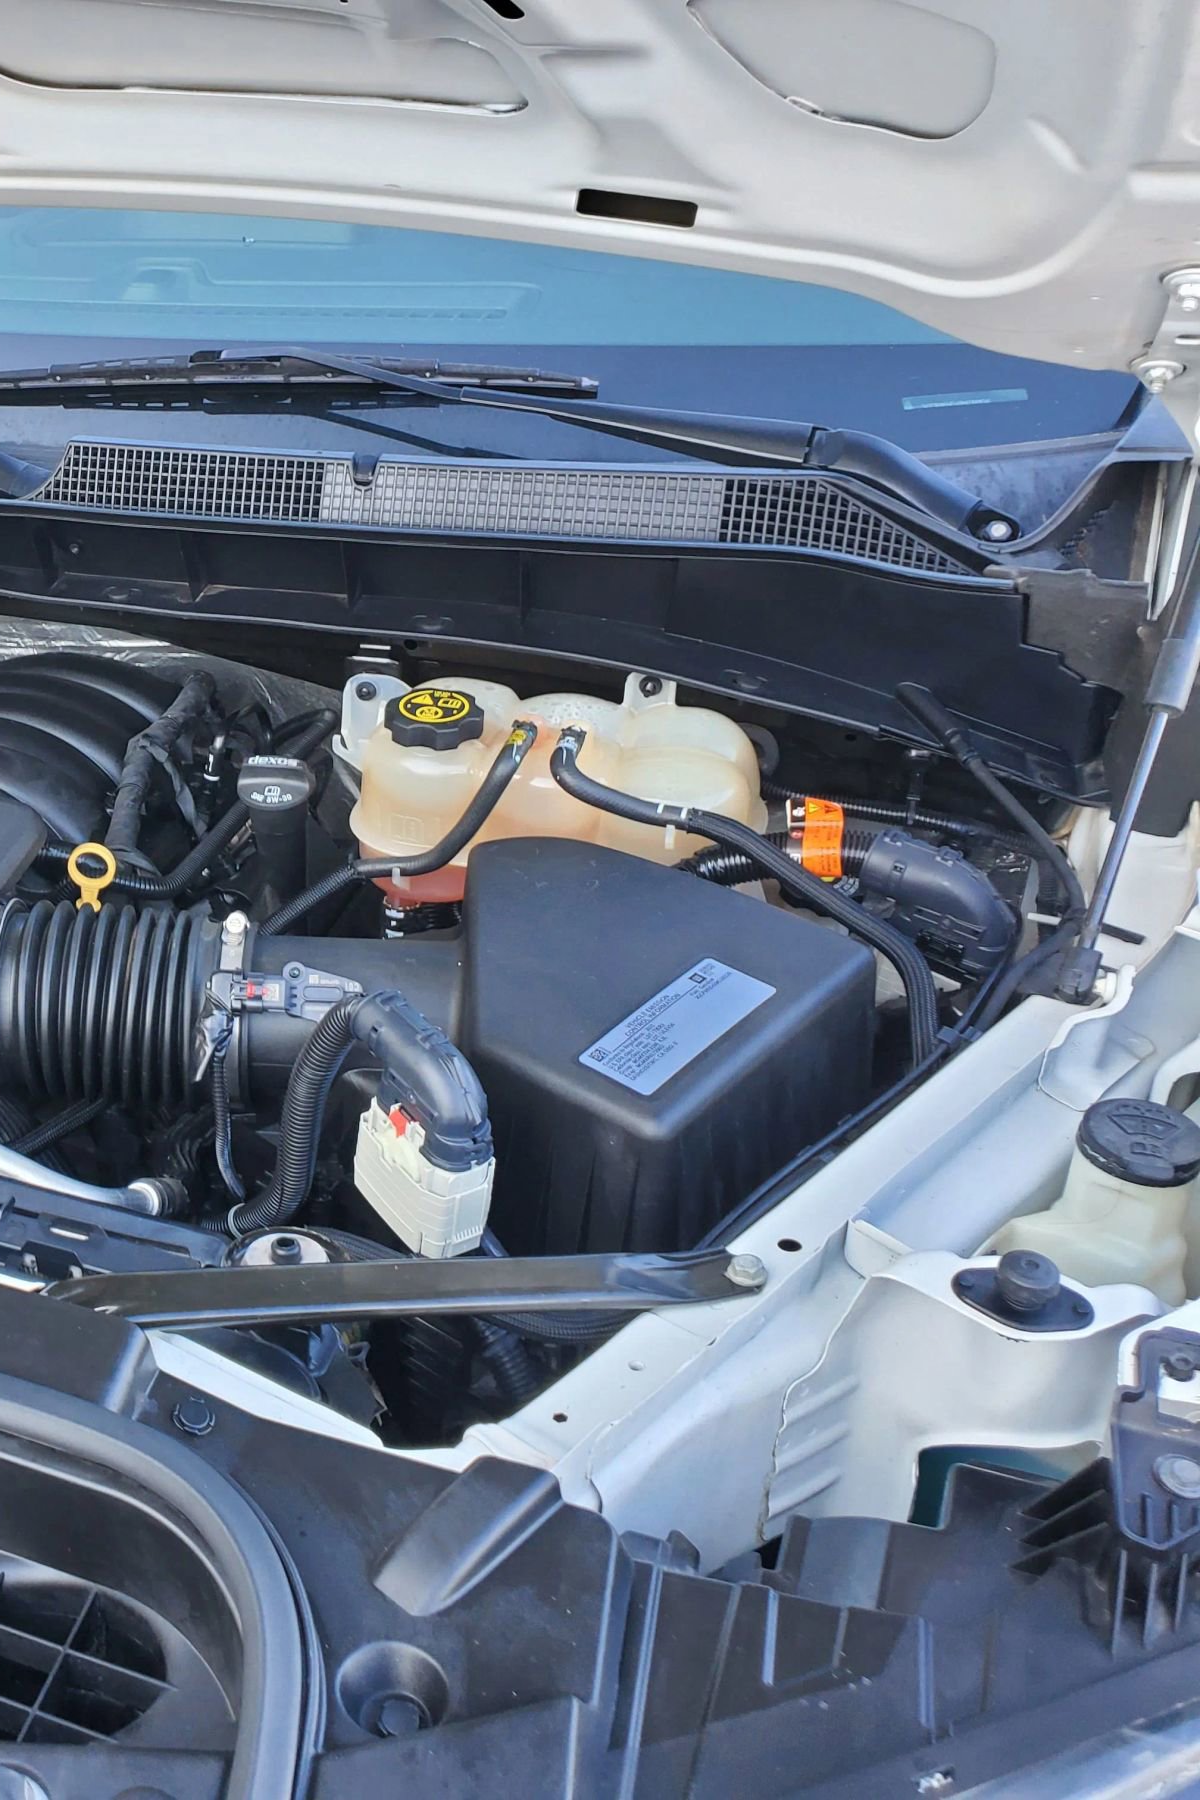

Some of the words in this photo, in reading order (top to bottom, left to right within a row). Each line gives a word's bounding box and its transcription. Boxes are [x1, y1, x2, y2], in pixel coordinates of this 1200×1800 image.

[625, 1017, 649, 1037] CONTROL
[648, 993, 681, 1019] INFORMATION
[626, 1011, 647, 1028] VEHICLE
[645, 994, 670, 1013] EMISSION
